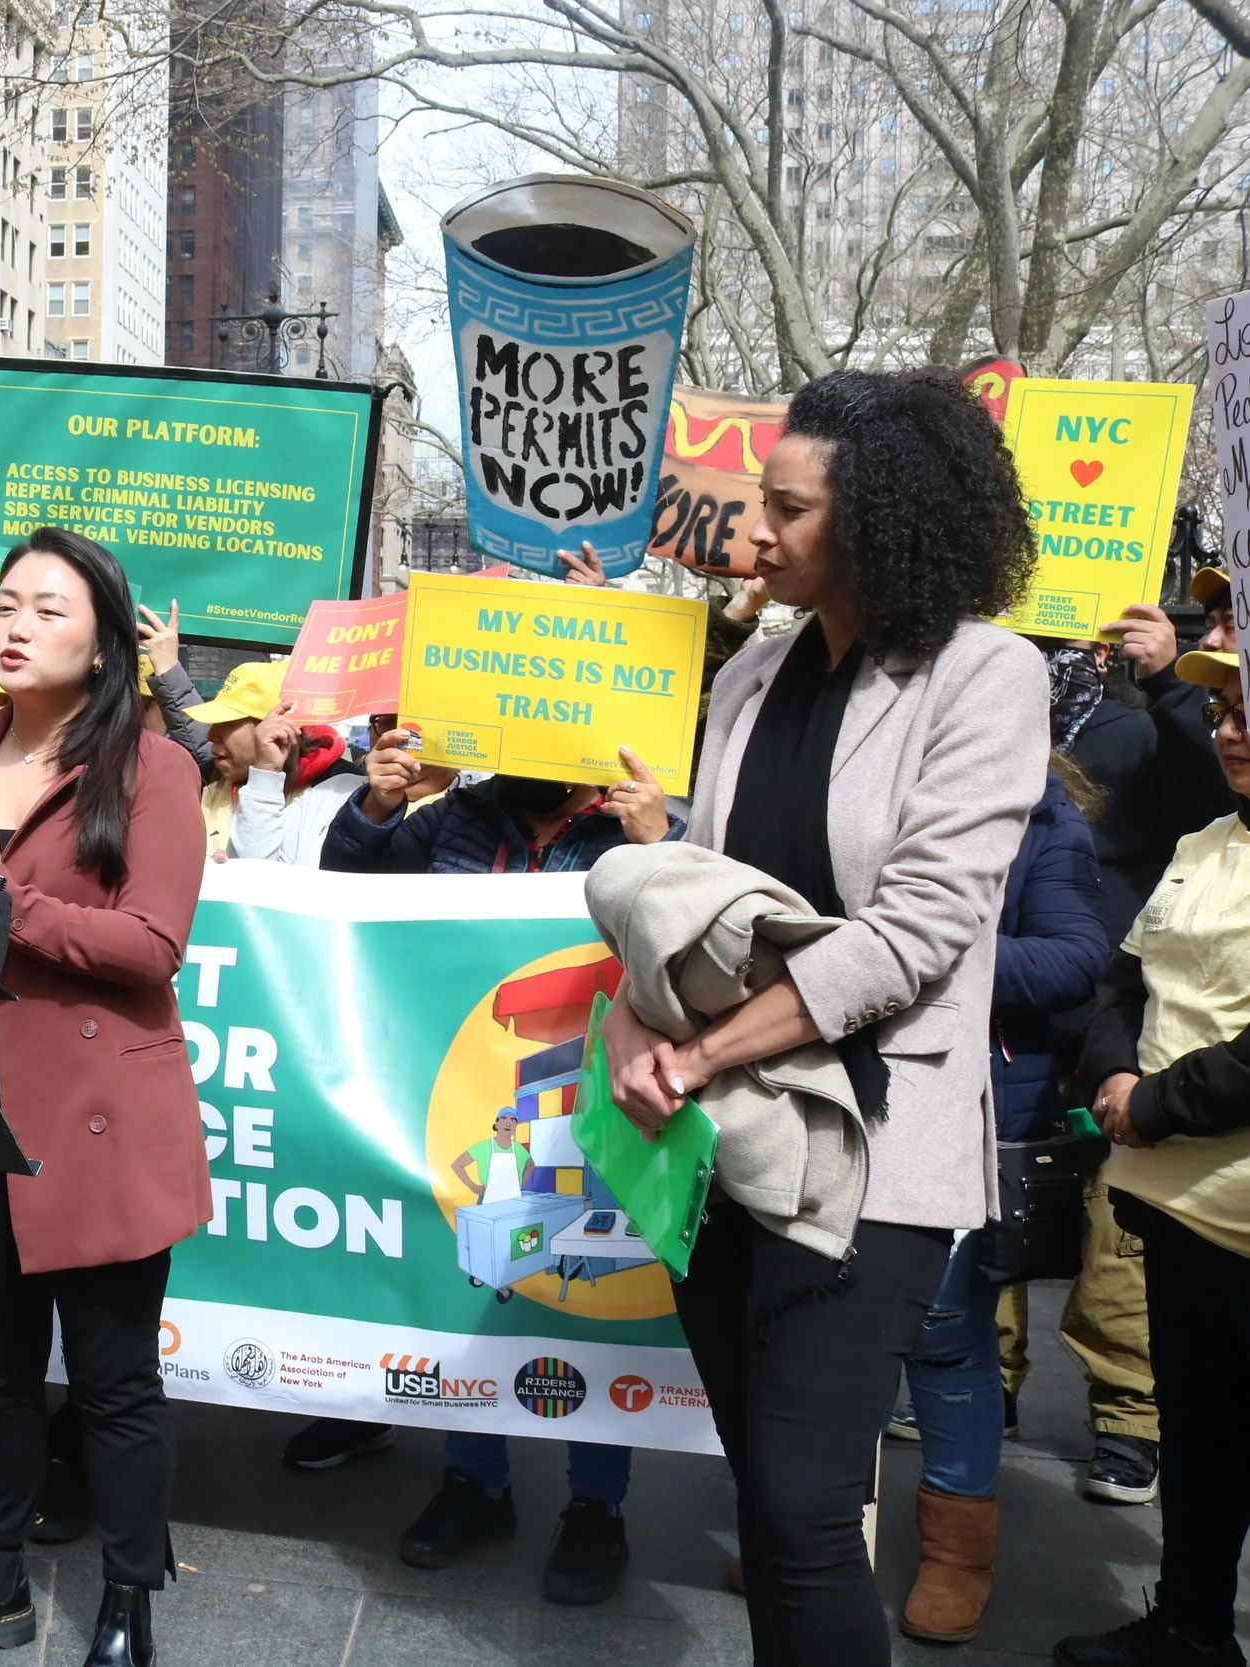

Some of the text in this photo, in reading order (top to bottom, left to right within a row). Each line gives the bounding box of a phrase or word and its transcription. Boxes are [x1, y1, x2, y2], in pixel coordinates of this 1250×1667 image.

[476, 334, 649, 406] MORE
[68, 414, 261, 449] OUR PLATFORM:
[470, 386, 648, 470] PERMITS
[1055, 415, 1132, 445] NYC
[6, 463, 316, 502] ACCESS TO BUSINESS LICENSING
[480, 453, 645, 522] NOW!
[5, 481, 265, 516] REPEAL CRIMINAL LIABILITY
[4, 501, 274, 536] SBS SERVICES FOR VENDORS
[650, 474, 745, 568] ORE
[1029, 499, 1136, 529] STREET
[126, 529, 210, 550] VENDING
[216, 536, 324, 561] LOCATIONS
[1037, 532, 1145, 563] NDORS
[1037, 602, 1078, 612] VENDOR
[1038, 594, 1074, 604] STREET
[206, 603, 305, 624] #StreetVendorRe
[1035, 618, 1089, 630] COALITION
[1036, 610, 1076, 620] JUSTICE
[326, 618, 400, 644] DON'T
[477, 609, 628, 646] MY SMALL
[304, 647, 395, 674] ME LIKE
[424, 644, 675, 692] BUSINESS IS NOT
[497, 693, 593, 725] TRASH
[446, 743, 478, 751] JUSTICE
[447, 730, 474, 738] STREET
[447, 737, 478, 745] VENDOR
[446, 750, 488, 759] COALITION
[178, 944, 238, 1009] T
[280, 1351, 371, 1371] The Arab American
[280, 1364, 347, 1380] Association of
[280, 1376, 324, 1390] New York
[517, 1386, 585, 1399] ALLIANCE
[525, 1377, 577, 1388] RIDERS
[659, 1385, 707, 1397] TRANSP
[385, 1397, 409, 1405] United
[410, 1398, 420, 1406] for
[422, 1399, 443, 1407] Small
[444, 1400, 479, 1408] Business
